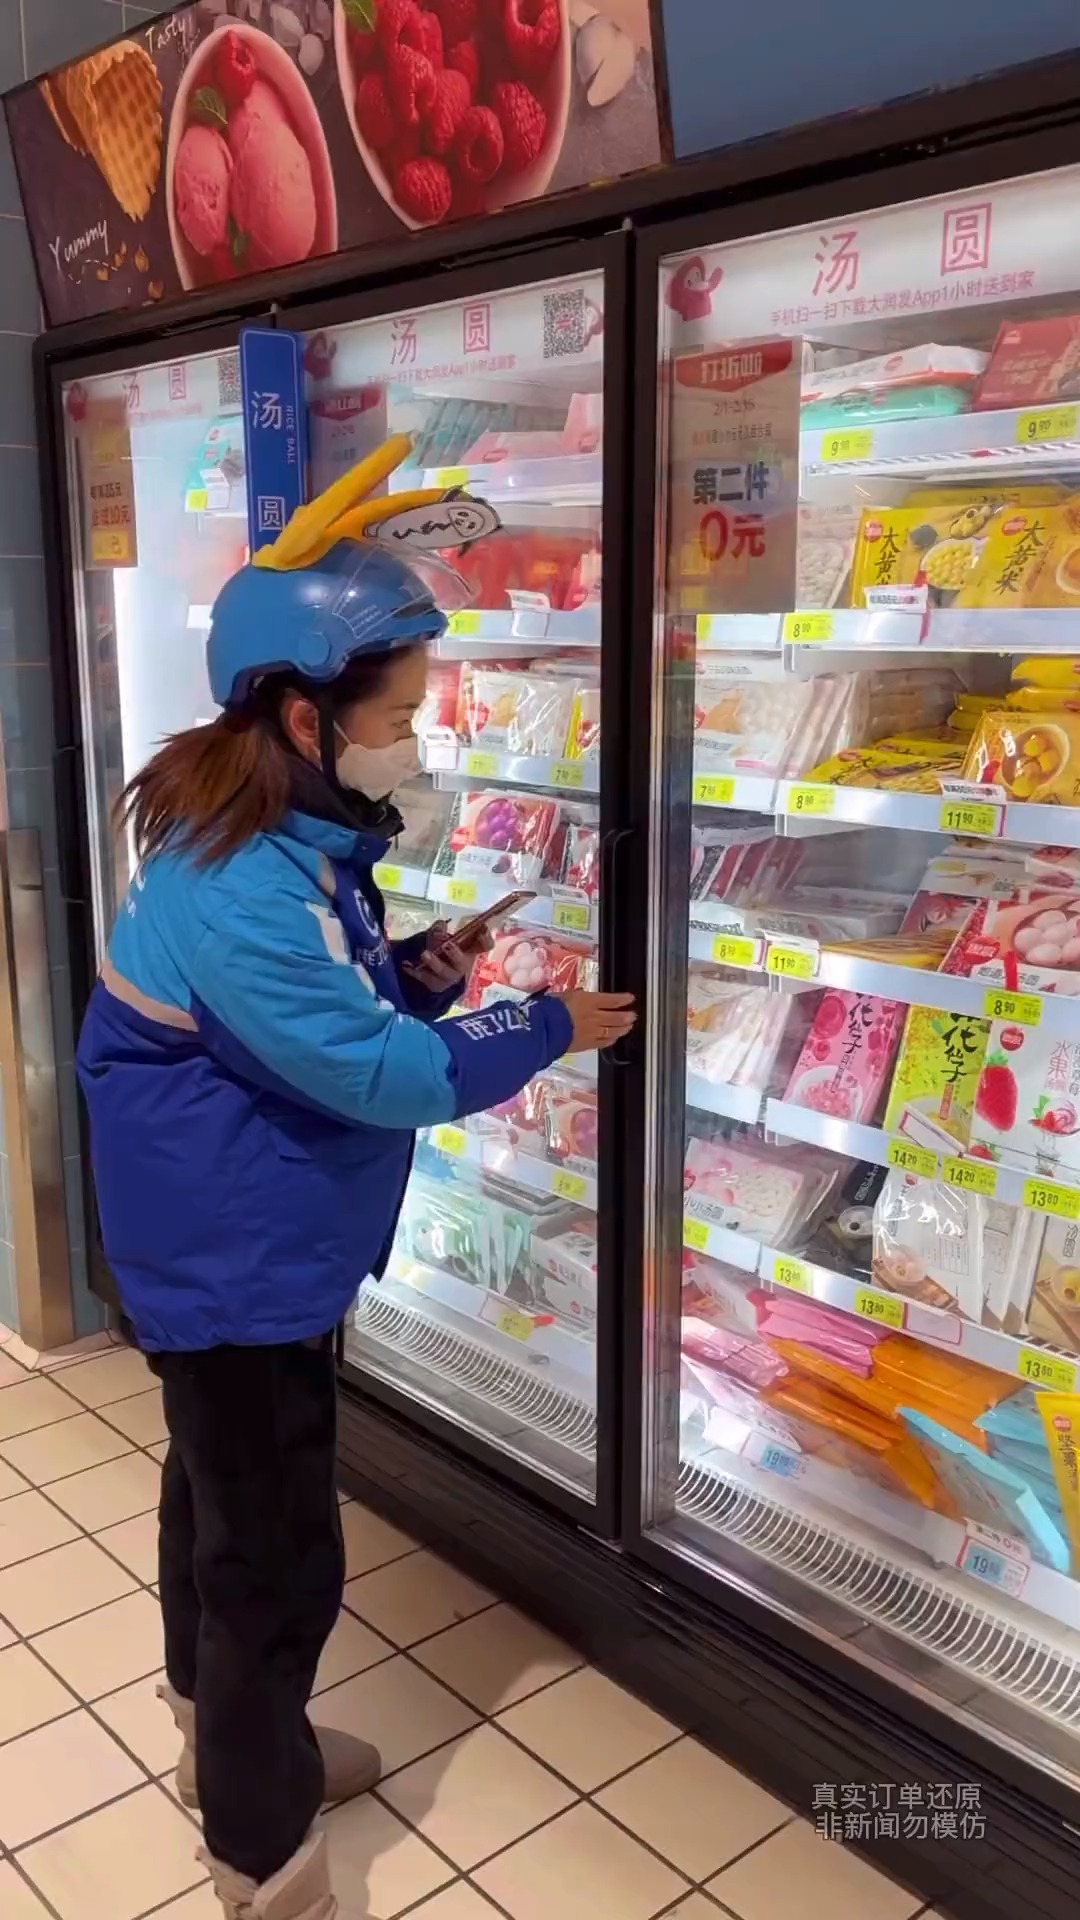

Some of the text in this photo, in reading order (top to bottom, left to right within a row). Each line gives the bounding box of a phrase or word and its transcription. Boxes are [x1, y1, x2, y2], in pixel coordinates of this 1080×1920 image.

[49, 220, 109, 269] Yummy
[812, 203, 992, 296] 汤圆
[389, 302, 490, 365] 汤圆
[251, 391, 286, 534] 汤圆
[693, 460, 770, 505] 第二件
[699, 510, 766, 562] 0元
[874, 525, 901, 586] 大黄
